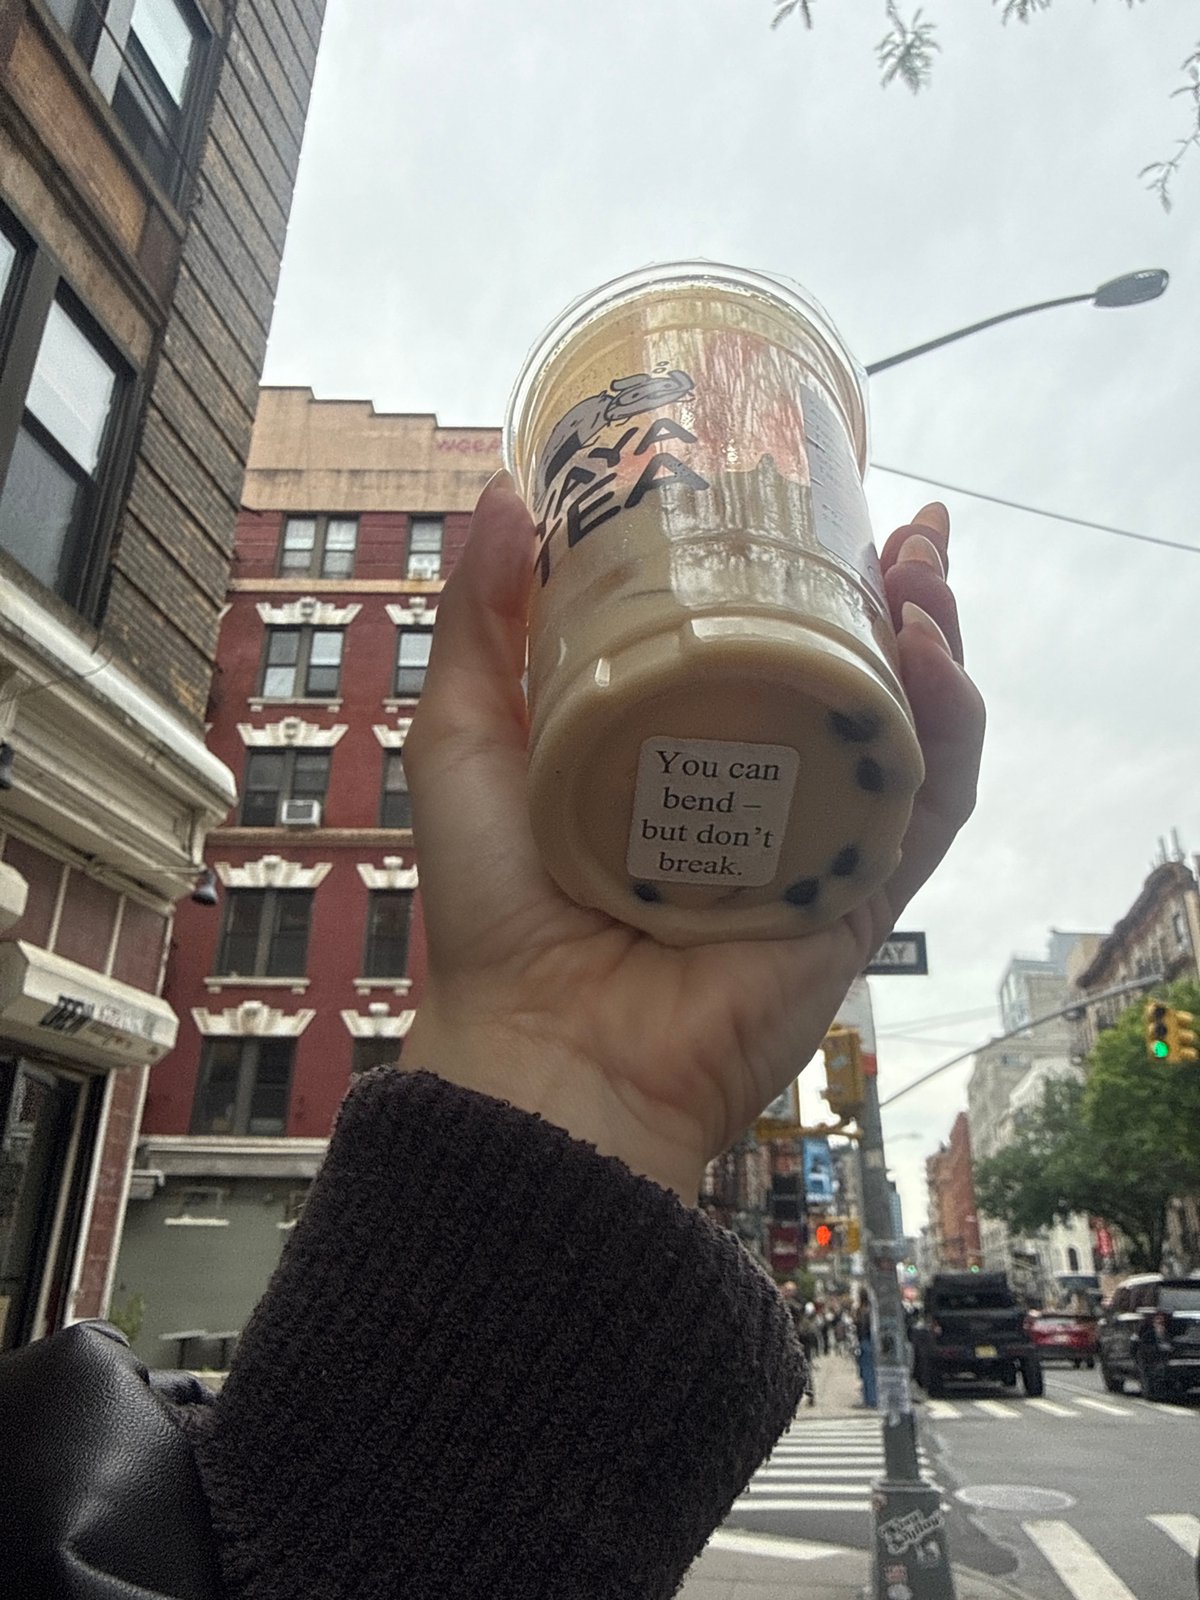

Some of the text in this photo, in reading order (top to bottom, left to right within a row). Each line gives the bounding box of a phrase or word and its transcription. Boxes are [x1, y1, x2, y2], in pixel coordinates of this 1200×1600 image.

[535, 418, 698, 542] YAYA
[533, 453, 709, 588] TEA
[656, 750, 780, 781] You can
[663, 787, 734, 813] bend
[641, 819, 774, 848] but don't
[658, 852, 743, 876] break.
